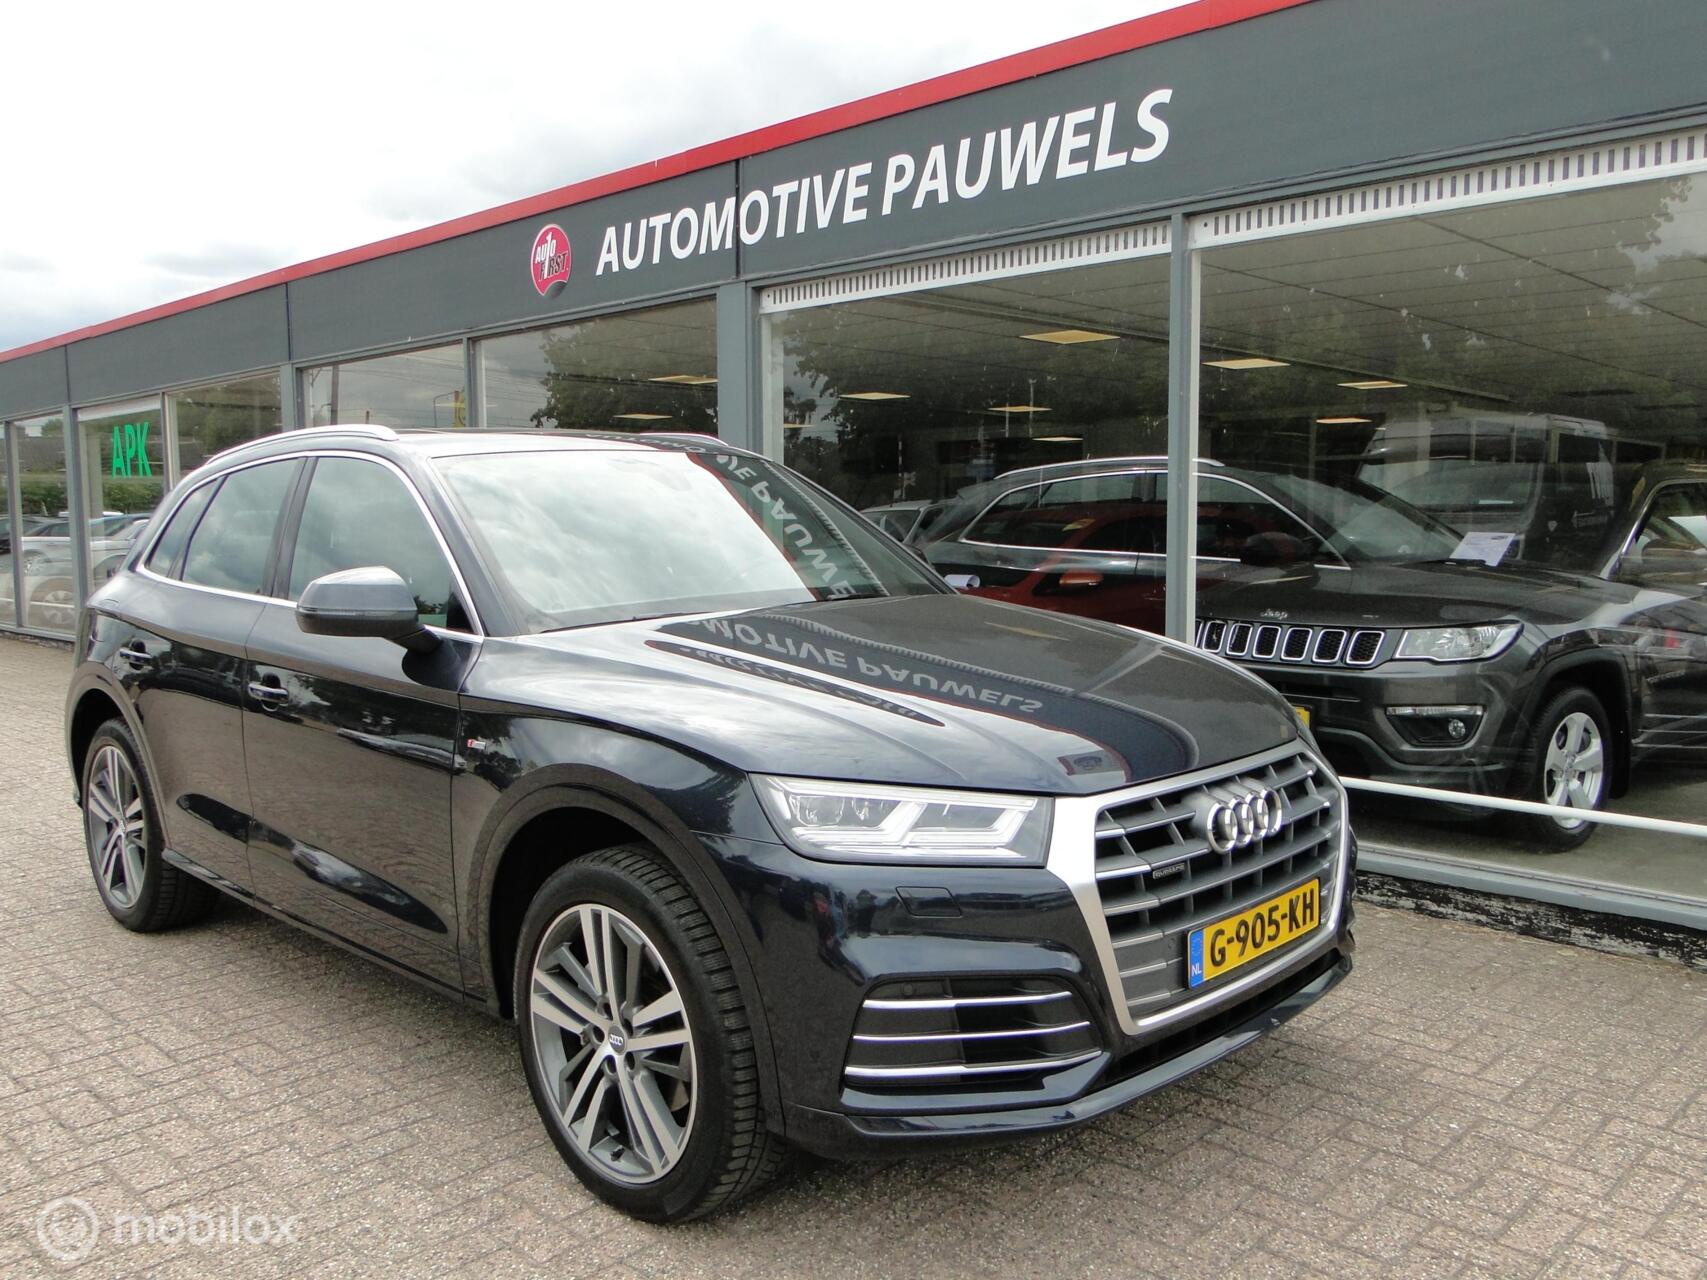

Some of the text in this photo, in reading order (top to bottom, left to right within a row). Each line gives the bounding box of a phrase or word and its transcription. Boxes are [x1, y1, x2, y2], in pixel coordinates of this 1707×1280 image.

[595, 88, 1173, 276] AUTOMOTIVE PAUWELS
[111, 421, 152, 478] APK
[1210, 888, 1315, 967] G-905-KH
[1191, 962, 1203, 977] NL
